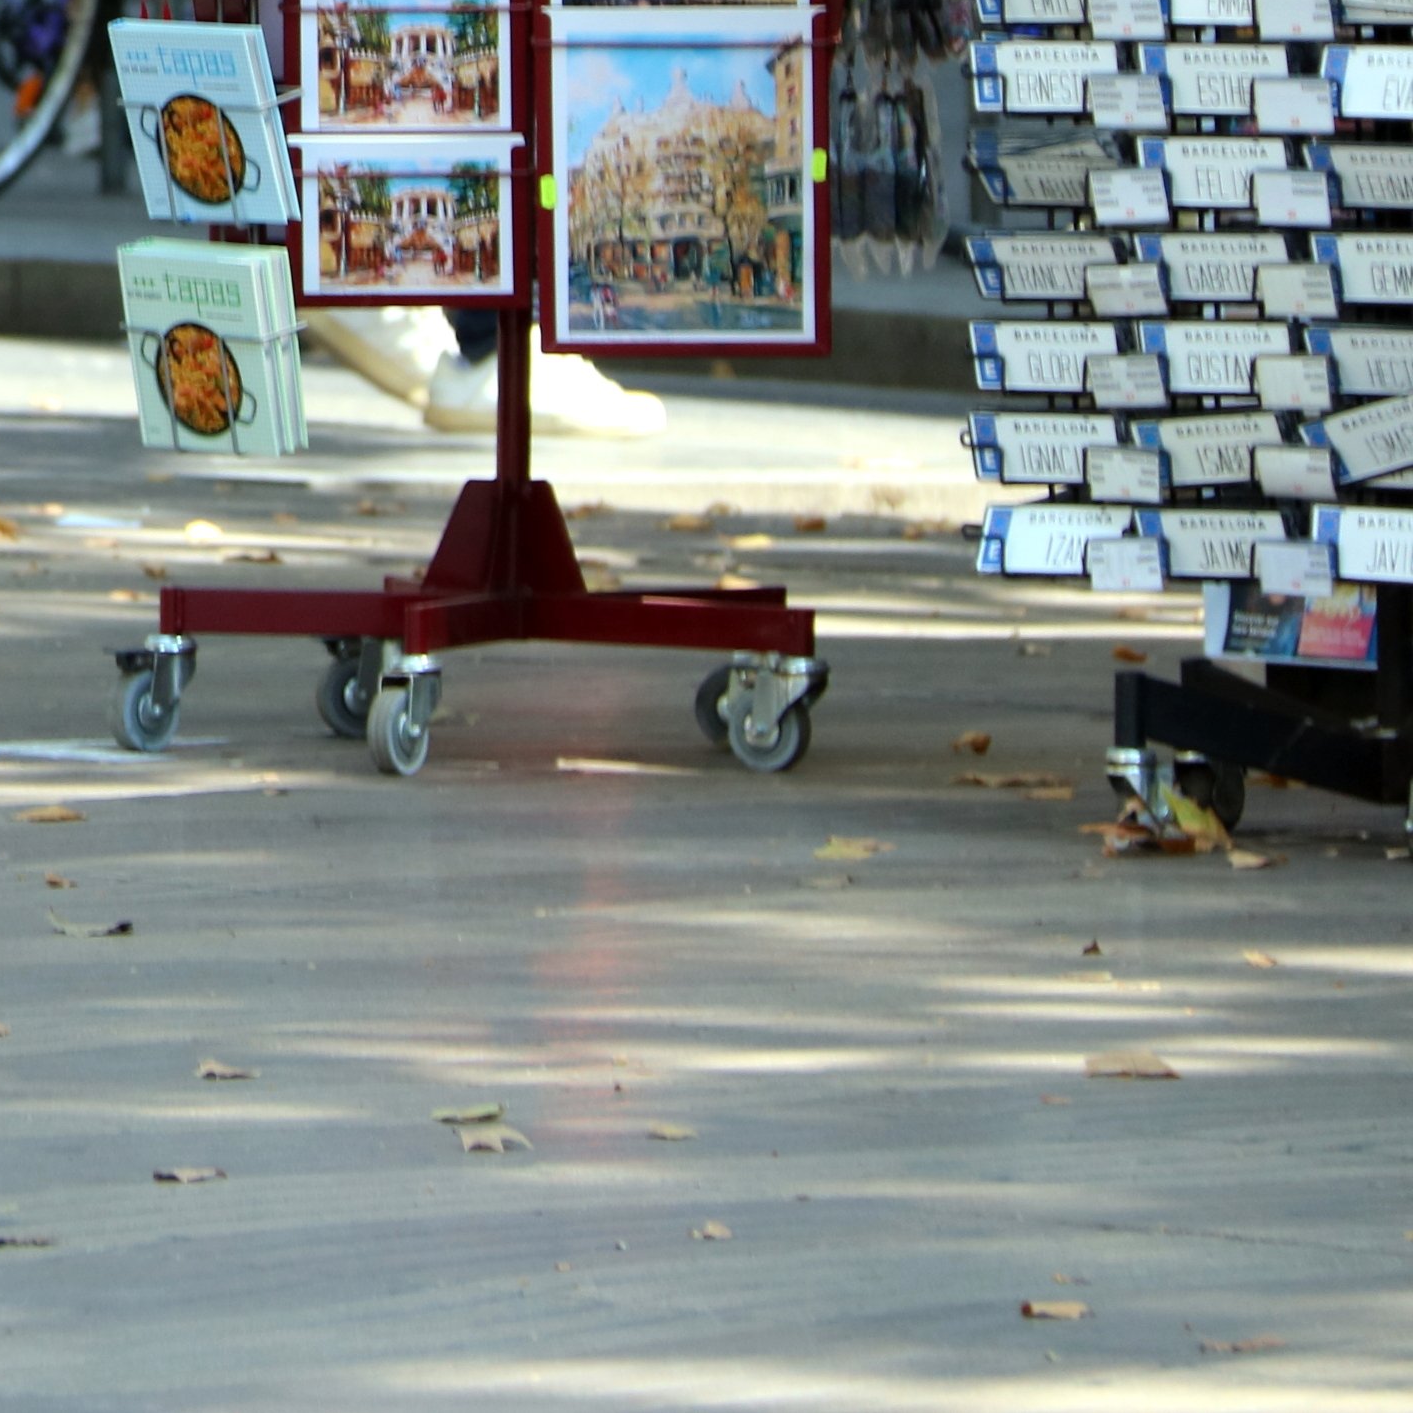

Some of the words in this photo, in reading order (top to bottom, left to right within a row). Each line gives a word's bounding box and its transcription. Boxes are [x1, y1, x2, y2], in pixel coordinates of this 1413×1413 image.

[1014, 49, 1101, 62] BARCELONA
[1183, 51, 1271, 66] BARCELONA
[158, 43, 236, 88] tapas
[1181, 145, 1268, 159] BARCELONA
[1011, 244, 1096, 256] BARCELONA
[1180, 240, 1268, 254] BARCELONA
[166, 270, 241, 315] tapas
[1014, 330, 1099, 343] BARCELONA
[1184, 329, 1272, 344] BARCELONA
[1014, 421, 1099, 435] BARCELONA
[1176, 419, 1262, 436] BARCELONA
[1029, 510, 1113, 525] BARCELONA
[1178, 516, 1267, 531] BARCELONA
